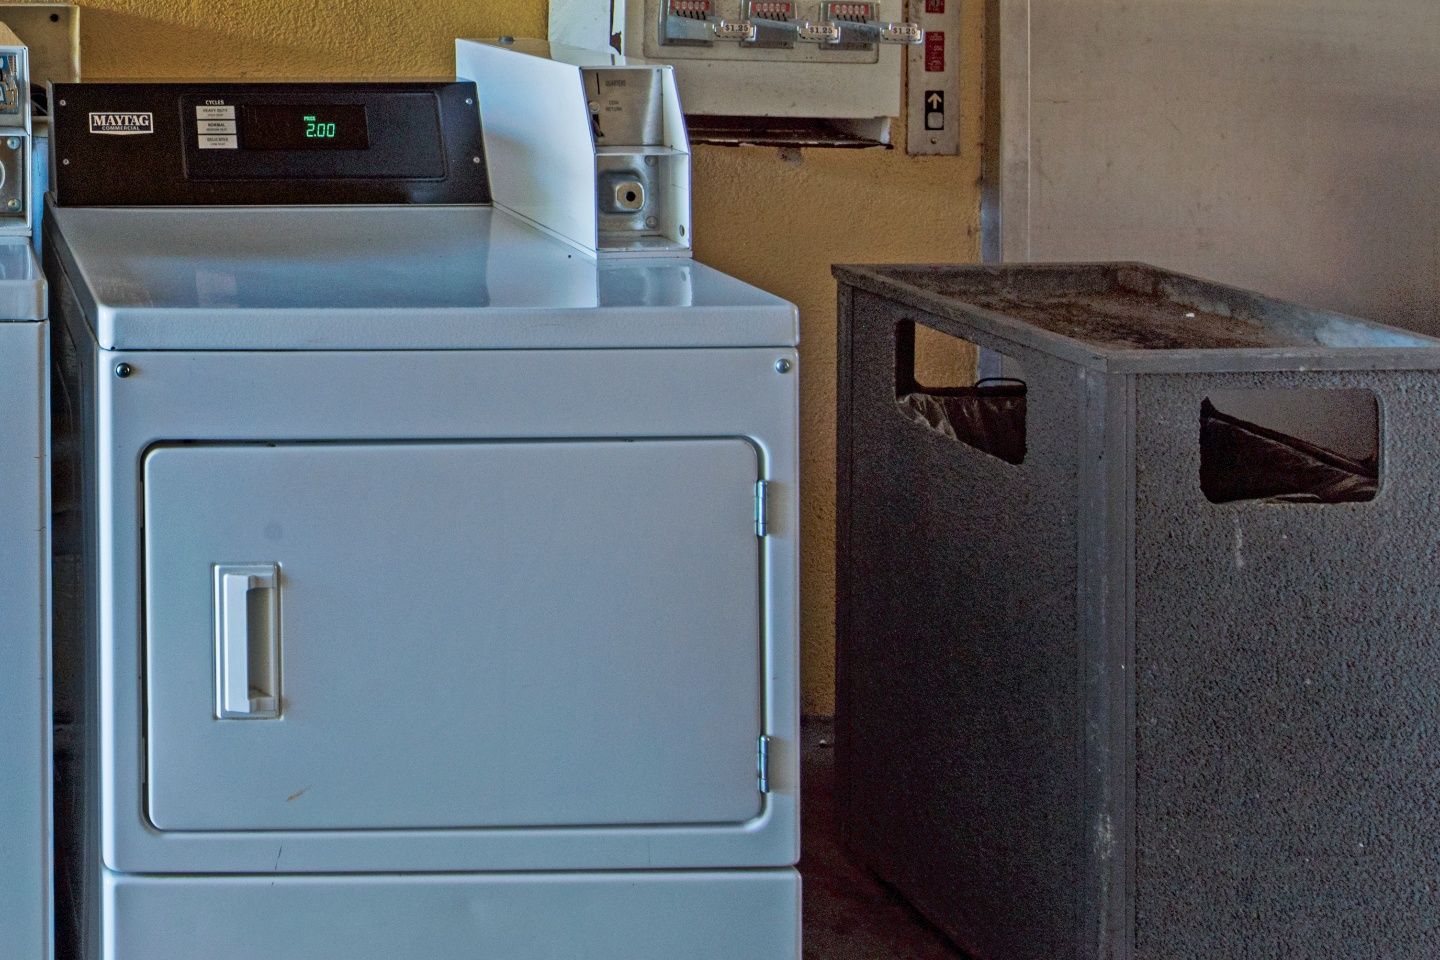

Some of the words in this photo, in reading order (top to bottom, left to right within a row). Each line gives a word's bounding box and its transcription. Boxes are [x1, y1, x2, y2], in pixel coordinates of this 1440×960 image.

[724, 24, 749, 32] $1.25
[810, 26, 833, 34] $1.25
[893, 26, 916, 35] $1.25
[93, 115, 149, 126] MAYTAG
[306, 123, 336, 137] 2.00
